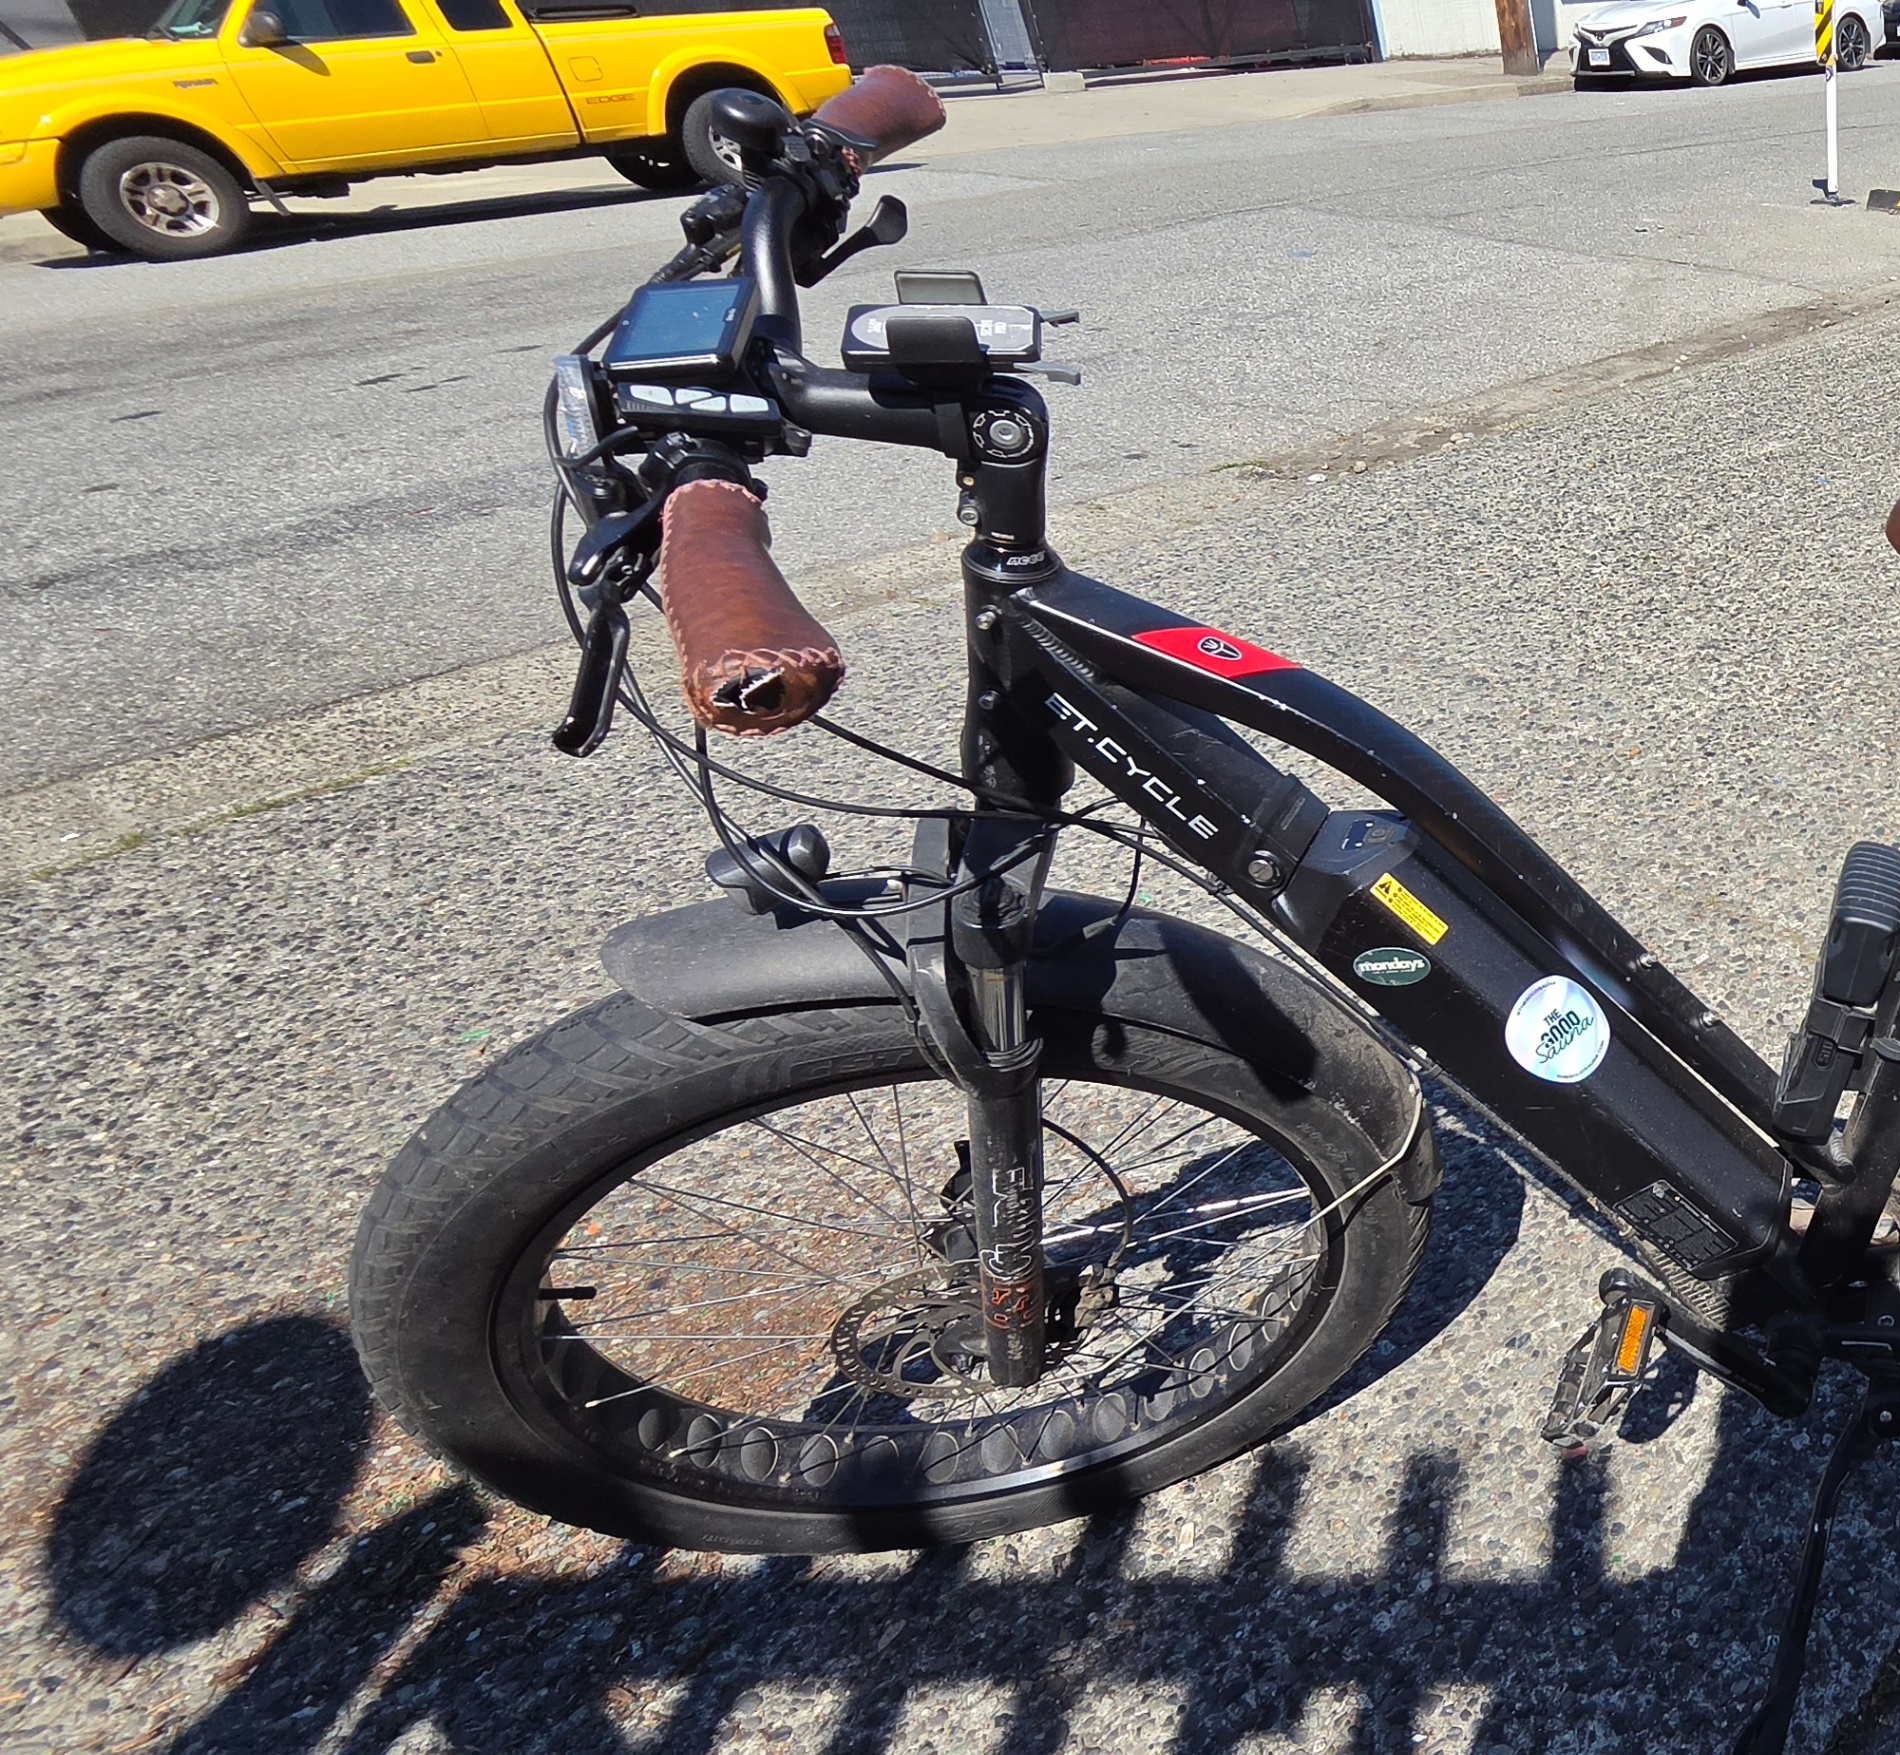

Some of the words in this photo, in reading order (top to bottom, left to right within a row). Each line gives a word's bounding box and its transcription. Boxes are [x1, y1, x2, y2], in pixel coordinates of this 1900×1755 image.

[585, 93, 636, 105] EDGE
[1358, 956, 1426, 972] mondays
[1543, 1008, 1563, 1026] THE
[1541, 1010, 1581, 1048] GOOD
[1535, 1016, 1595, 1064] Sauna
